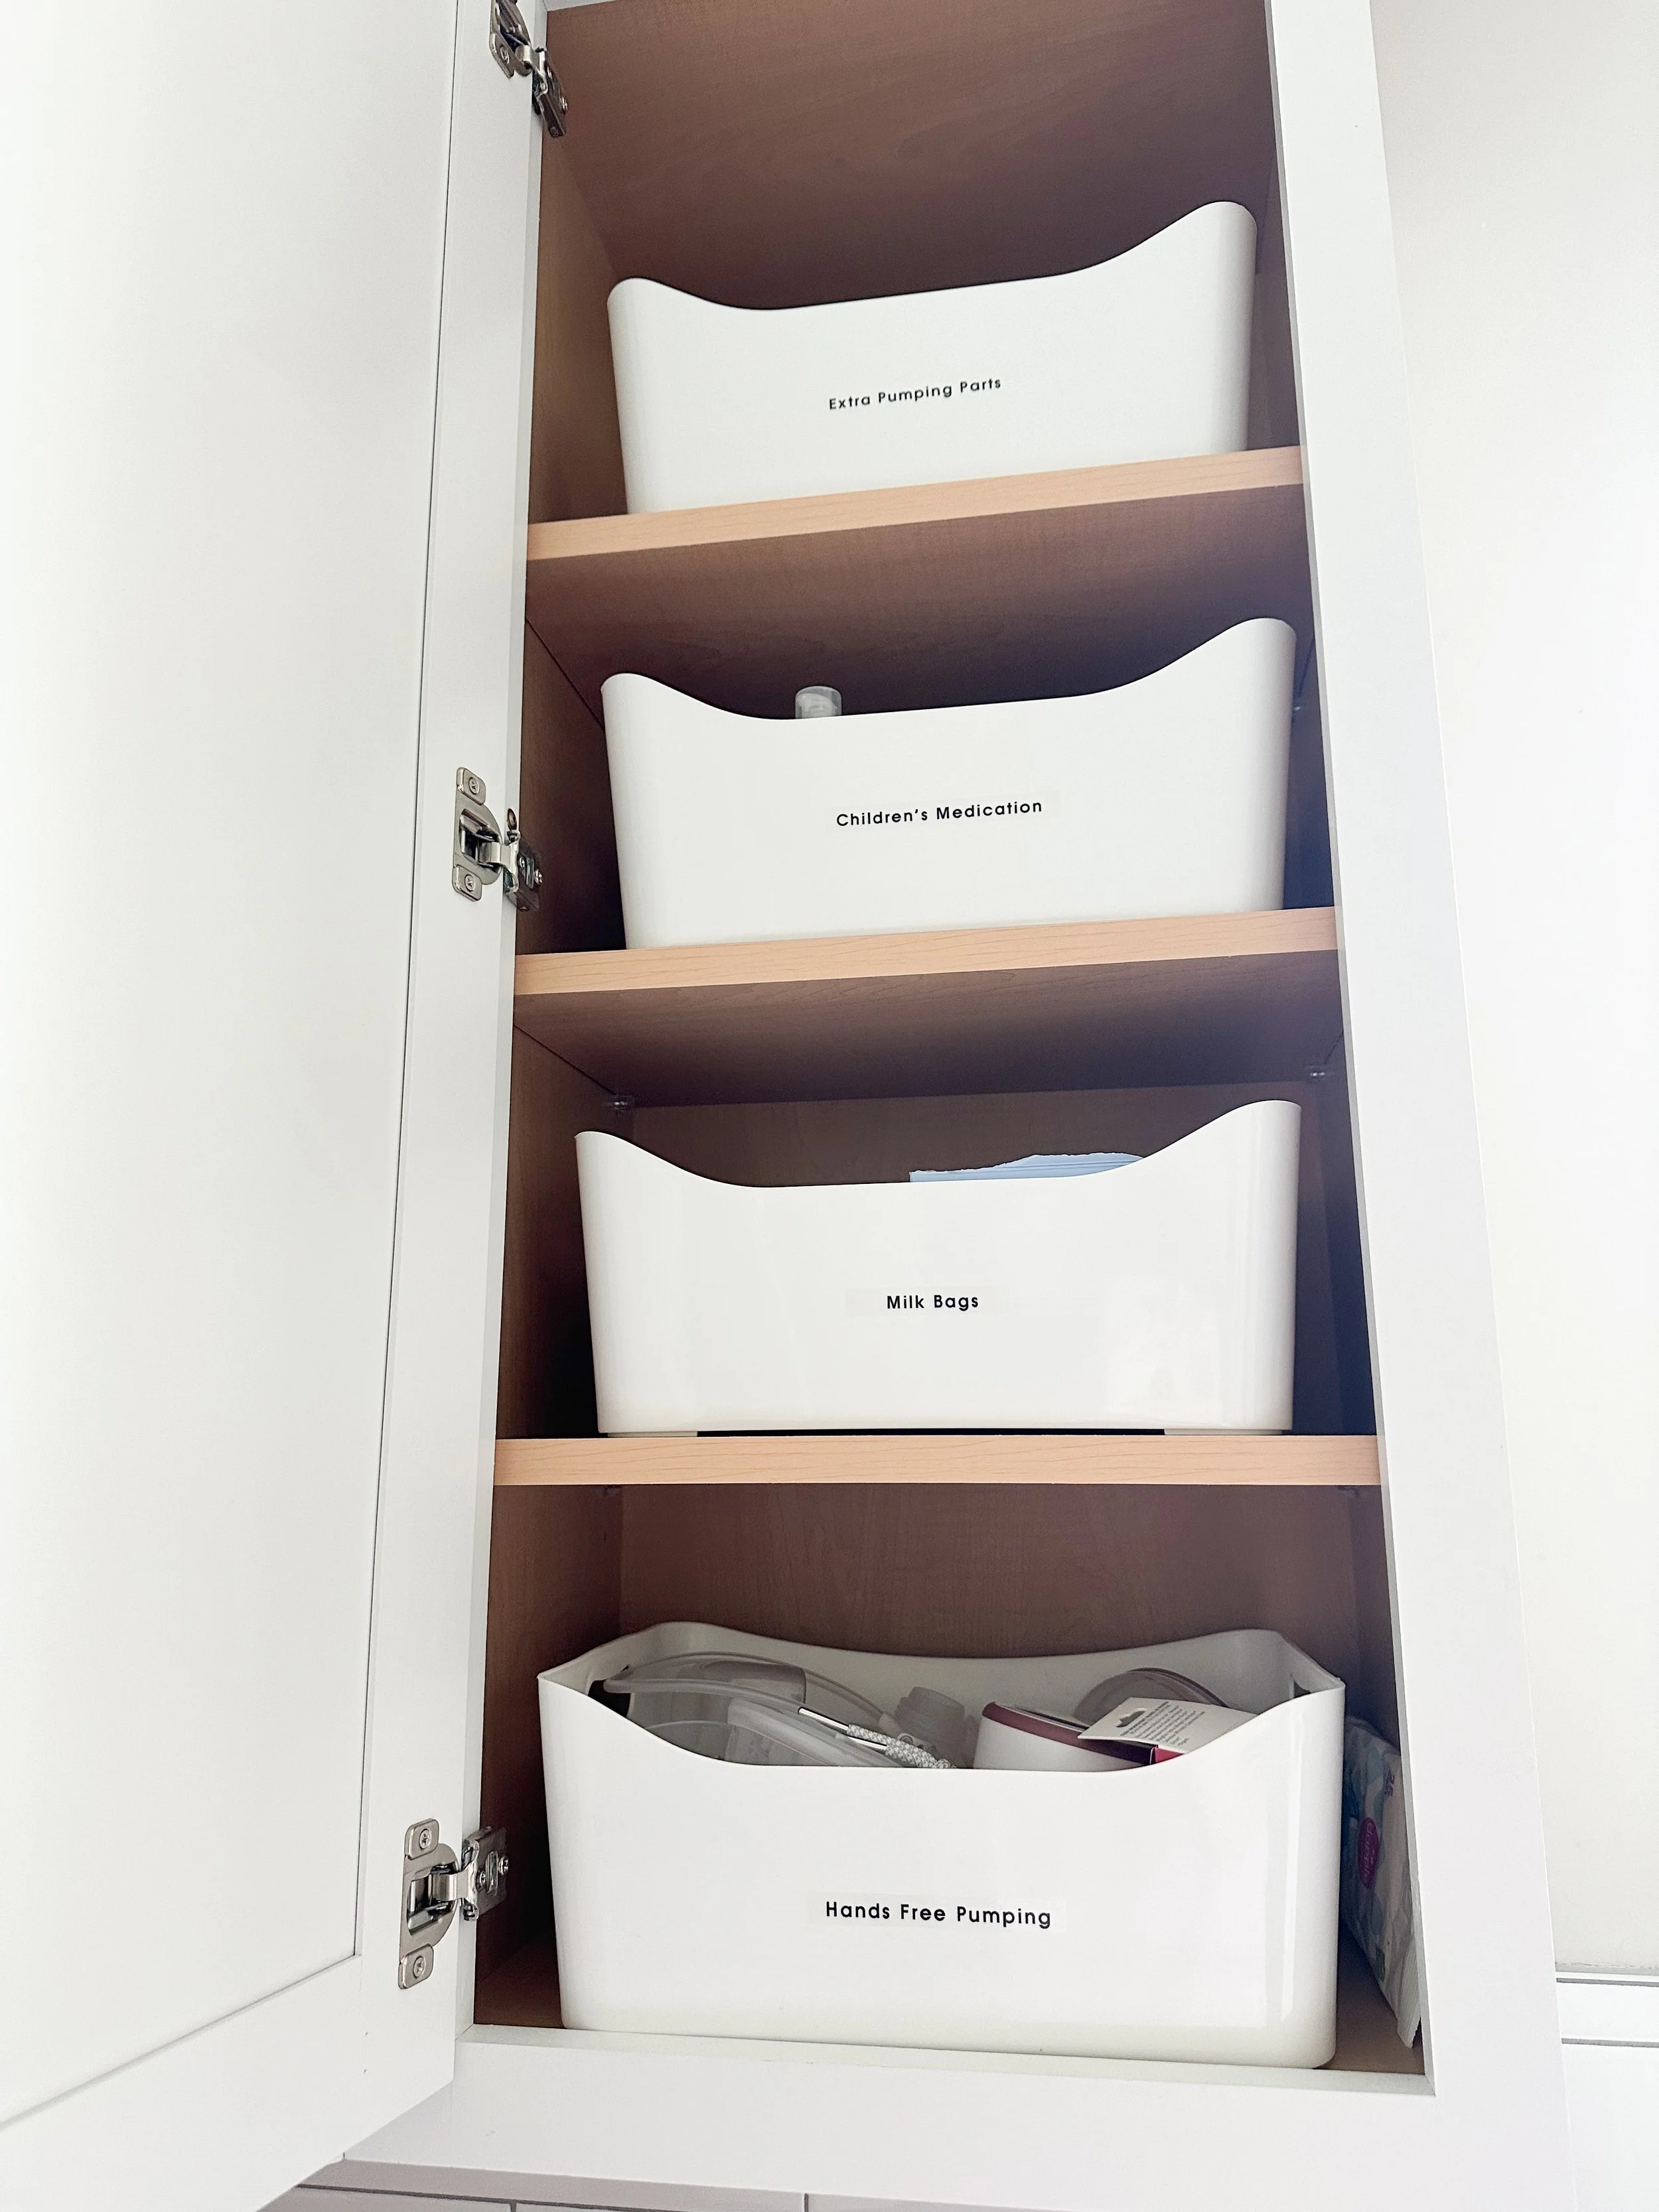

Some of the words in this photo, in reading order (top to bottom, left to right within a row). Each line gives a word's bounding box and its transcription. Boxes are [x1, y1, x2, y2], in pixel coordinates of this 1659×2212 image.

[829, 396, 871, 410] Extra
[878, 386, 952, 404] Pumping
[960, 378, 1001, 393] Parts
[836, 808, 928, 826] Children’s
[936, 801, 1042, 820] Medication
[887, 1295, 924, 1309] Milk
[934, 1294, 979, 1312] Bags
[826, 1901, 890, 1919] Hands
[901, 1903, 946, 1922] Free
[957, 1905, 1050, 1929] Pumping
